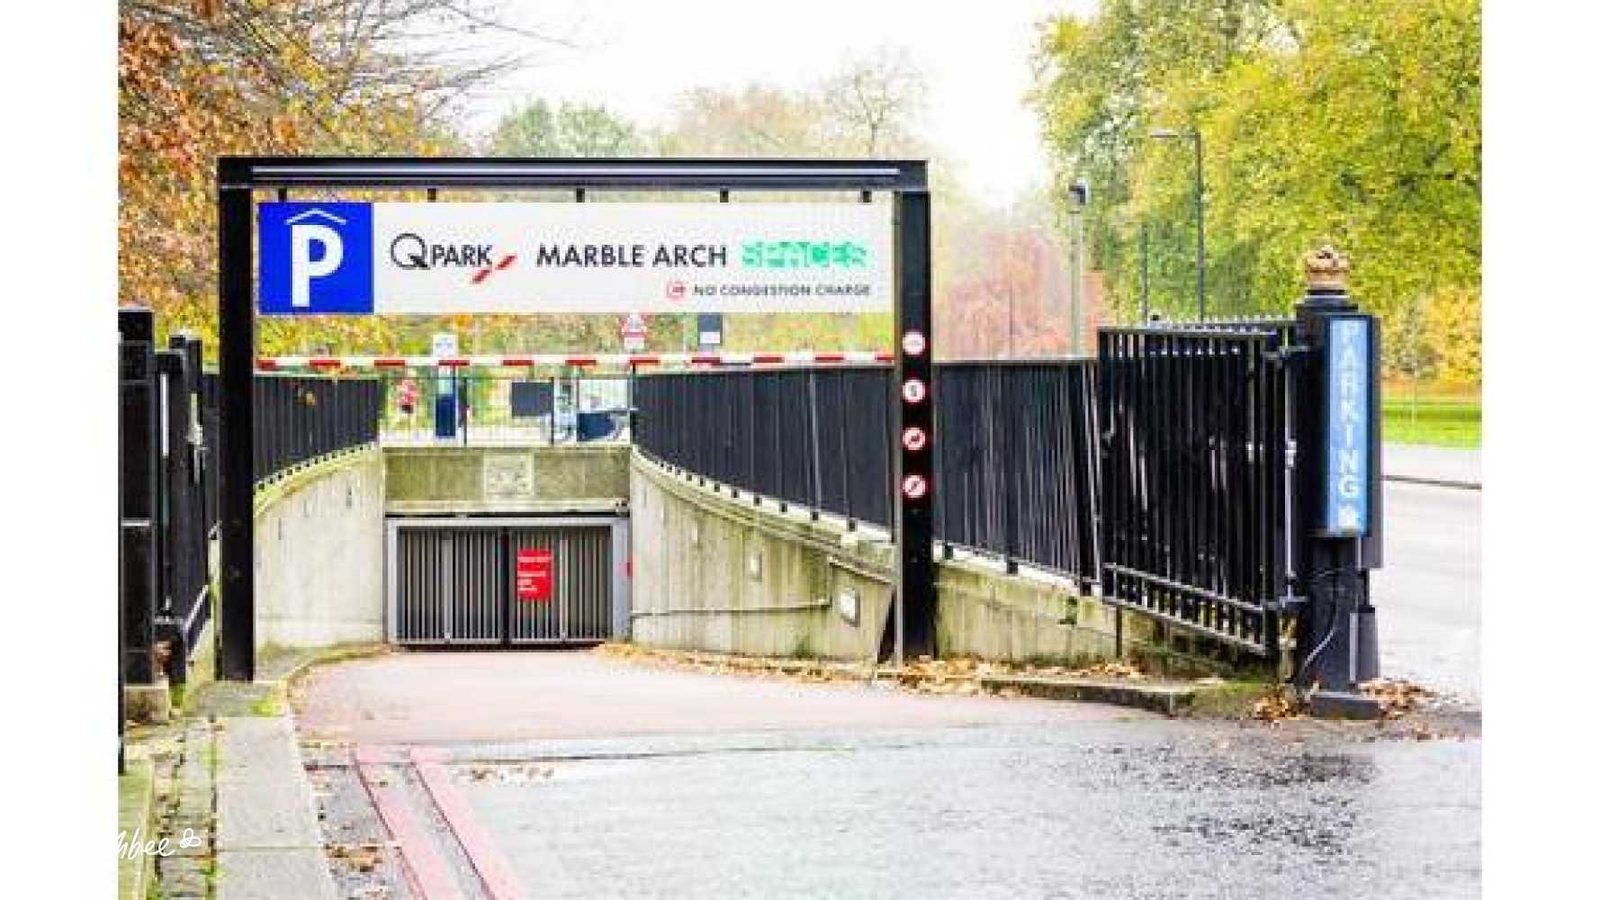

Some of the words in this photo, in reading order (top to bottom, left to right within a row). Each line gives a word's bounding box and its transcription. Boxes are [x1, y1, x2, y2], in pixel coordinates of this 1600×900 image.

[291, 224, 344, 307] P
[536, 244, 645, 268] MARBLE
[652, 244, 727, 268] ARCH
[693, 283, 716, 296] NO
[720, 283, 811, 296] CONGESTION
[815, 283, 871, 296] CHARGE
[1338, 320, 1360, 499] PARKING
